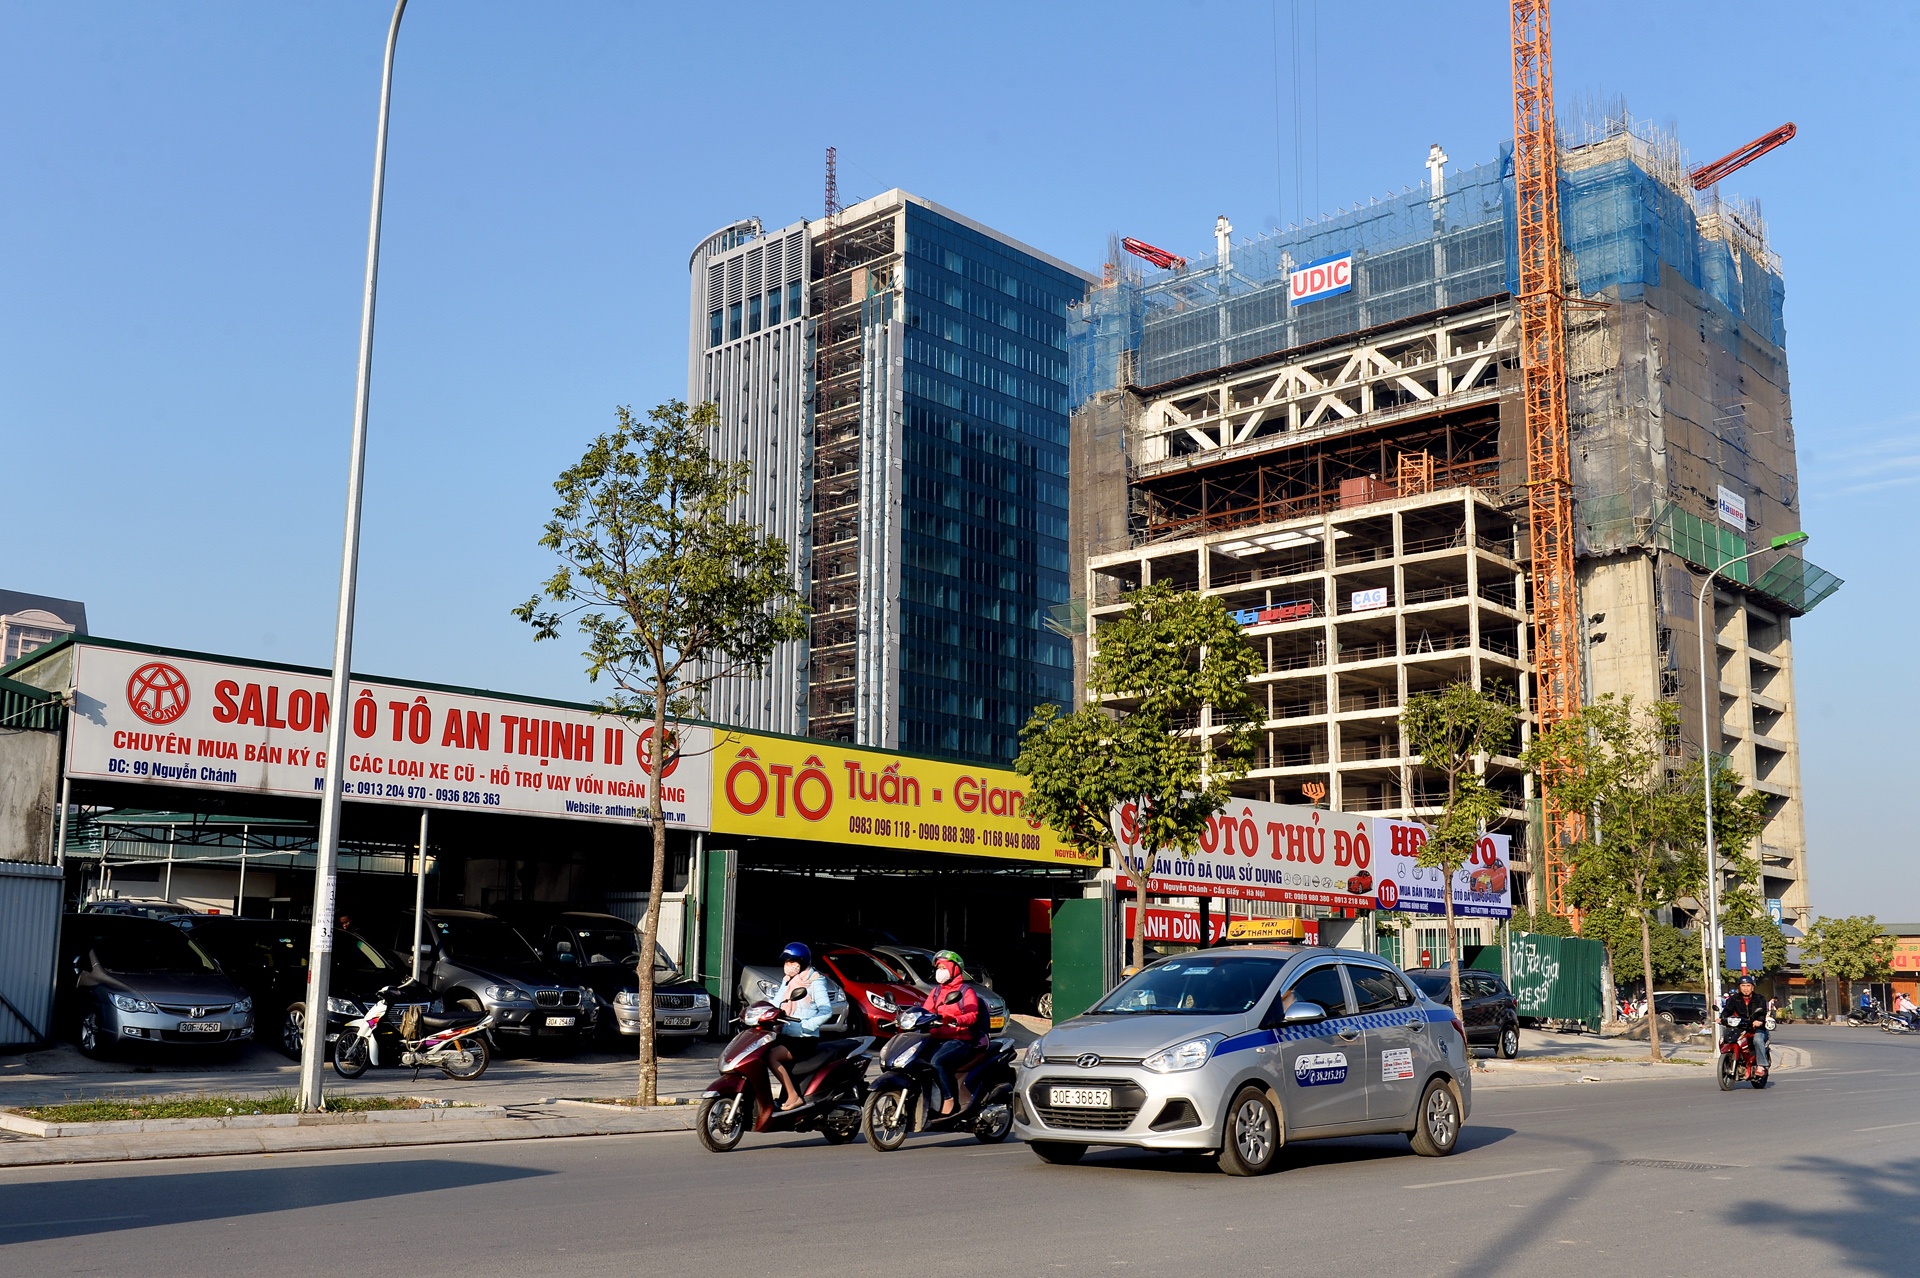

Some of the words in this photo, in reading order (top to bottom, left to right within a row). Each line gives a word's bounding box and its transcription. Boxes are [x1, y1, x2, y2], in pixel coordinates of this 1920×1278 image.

[1293, 261, 1348, 296] UDIC
[1719, 498, 1744, 520] Hawee
[1353, 591, 1381, 605] CAG
[212, 680, 330, 733] SALON
[353, 688, 378, 739] Ô
[389, 696, 431, 744] TÔ
[441, 708, 490, 751] AN
[500, 715, 594, 766] THỊNH
[108, 758, 130, 774] ĐC:
[133, 761, 148, 776] 99
[152, 763, 198, 782] Nguyễn
[200, 767, 237, 784] Chánh
[113, 730, 191, 755] CHUYÊN
[197, 739, 238, 760] MUA
[245, 740, 282, 764] BÁN
[288, 745, 310, 767] KÝ
[349, 752, 384, 775] CÁC
[388, 758, 424, 782] LOẠI
[429, 762, 449, 781] XE
[454, 763, 475, 783] CŨ
[490, 765, 510, 786] HỖ
[515, 772, 542, 791] TRỢ
[546, 775, 570, 792] VAY
[575, 773, 603, 795] VỐN
[608, 780, 646, 799] NGÂN
[660, 784, 685, 803] ÀNG
[357, 781, 382, 796] 0913
[386, 784, 404, 798] 204
[407, 786, 426, 800] 970
[436, 788, 460, 802] 0936
[462, 790, 480, 804] 826
[483, 792, 500, 806] 363
[725, 746, 834, 822] ÔTÔ
[844, 758, 921, 807] Tuấn
[565, 800, 603, 816] Website:
[849, 815, 872, 835] 0983
[874, 818, 891, 837] 096
[894, 820, 910, 839] 118
[918, 821, 940, 841] 0909
[942, 824, 958, 843] 888
[959, 826, 975, 845] 398
[983, 828, 1002, 848] 0168
[1004, 831, 1019, 850] 949
[1021, 833, 1040, 851] 8888
[1267, 811, 1325, 864] THỦ
[1333, 822, 1371, 868] ĐÔ
[1175, 858, 1195, 877] ÔTÔ
[1198, 861, 1213, 878] ĐÃ
[1216, 865, 1236, 881] QUA
[1239, 863, 1253, 882] SỬ
[1255, 866, 1282, 886] DỤNG
[1163, 882, 1187, 892] Nguyễn
[1188, 884, 1207, 893] Chánh
[1246, 889, 1255, 897] Hà
[1380, 885, 1395, 902] 11B
[1247, 929, 1273, 937] THANH
[1275, 928, 1291, 936] NGA
[1052, 1089, 1108, 1105] 30E-368.52
